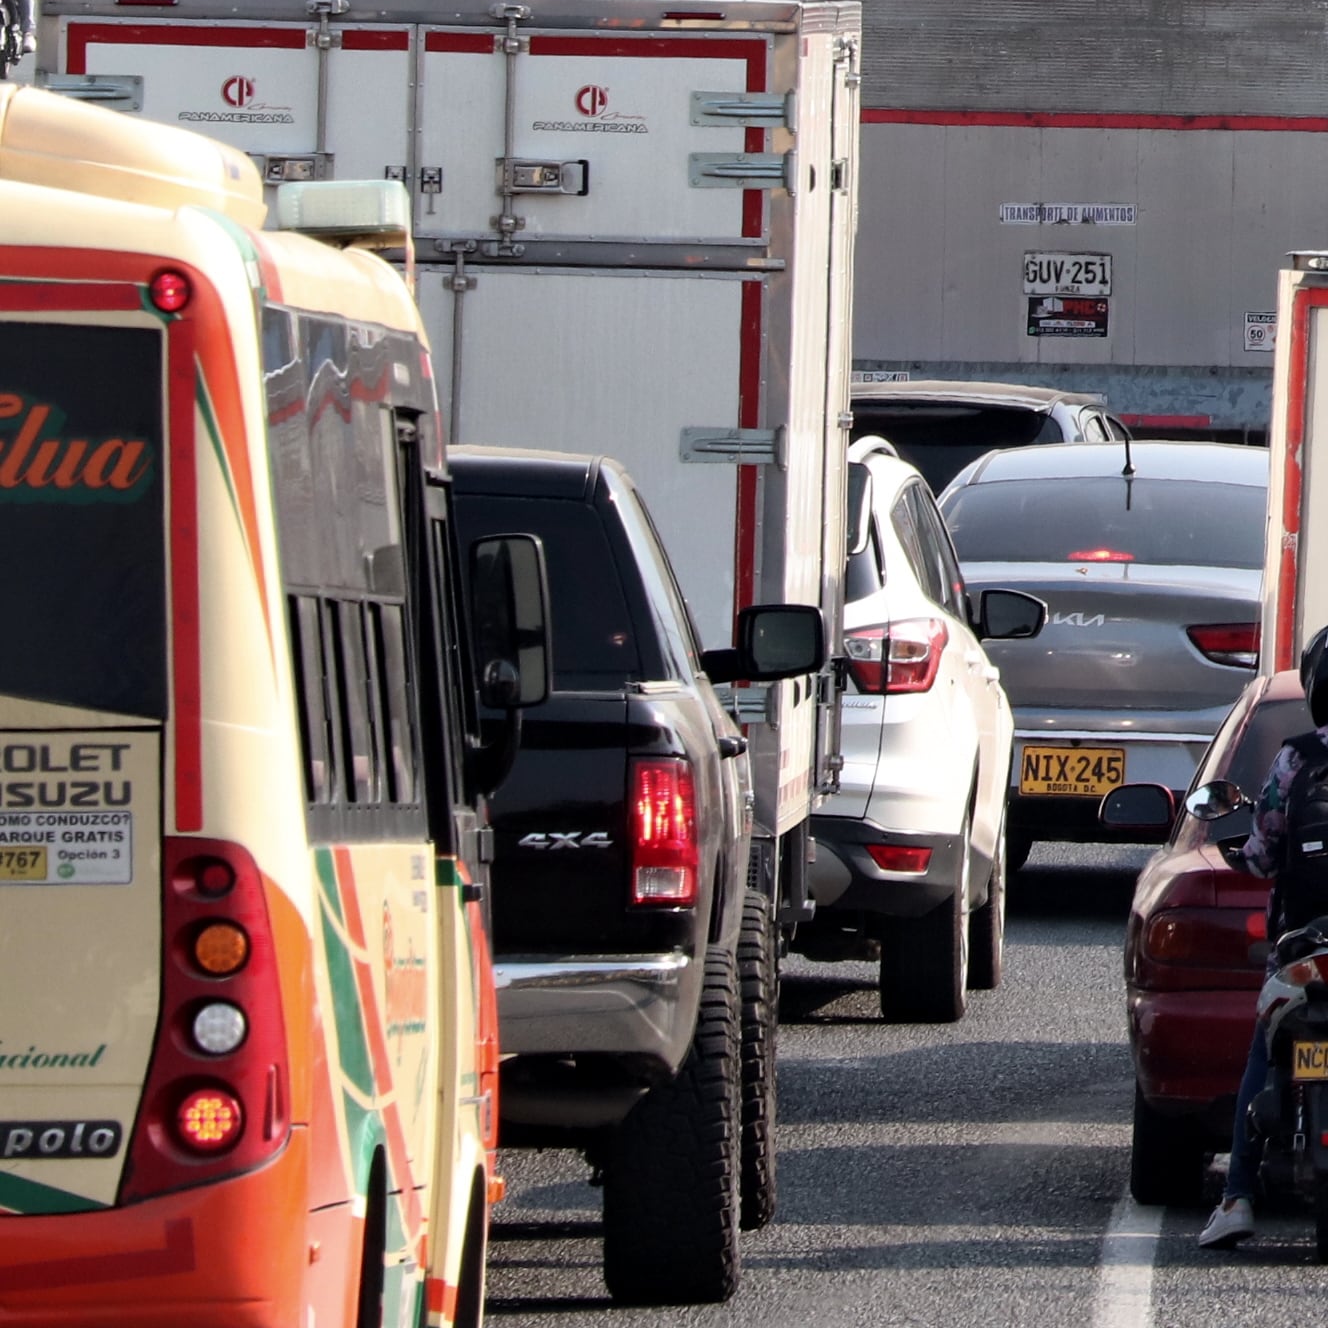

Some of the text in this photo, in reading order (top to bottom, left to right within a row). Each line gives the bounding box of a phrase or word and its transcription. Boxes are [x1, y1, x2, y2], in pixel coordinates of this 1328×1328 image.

[178, 112, 294, 124] PANAMERICANA
[532, 121, 649, 134] PANAMERICANA
[1005, 207, 1133, 222] TRANSPORTE DE ALIMENTOS
[1250, 329, 1263, 339] 50
[36, 814, 130, 826] CONDUZCO?
[61, 831, 125, 843] GRATIS
[57, 849, 121, 862] Opción 3
[4, 1123, 115, 1156] polo
